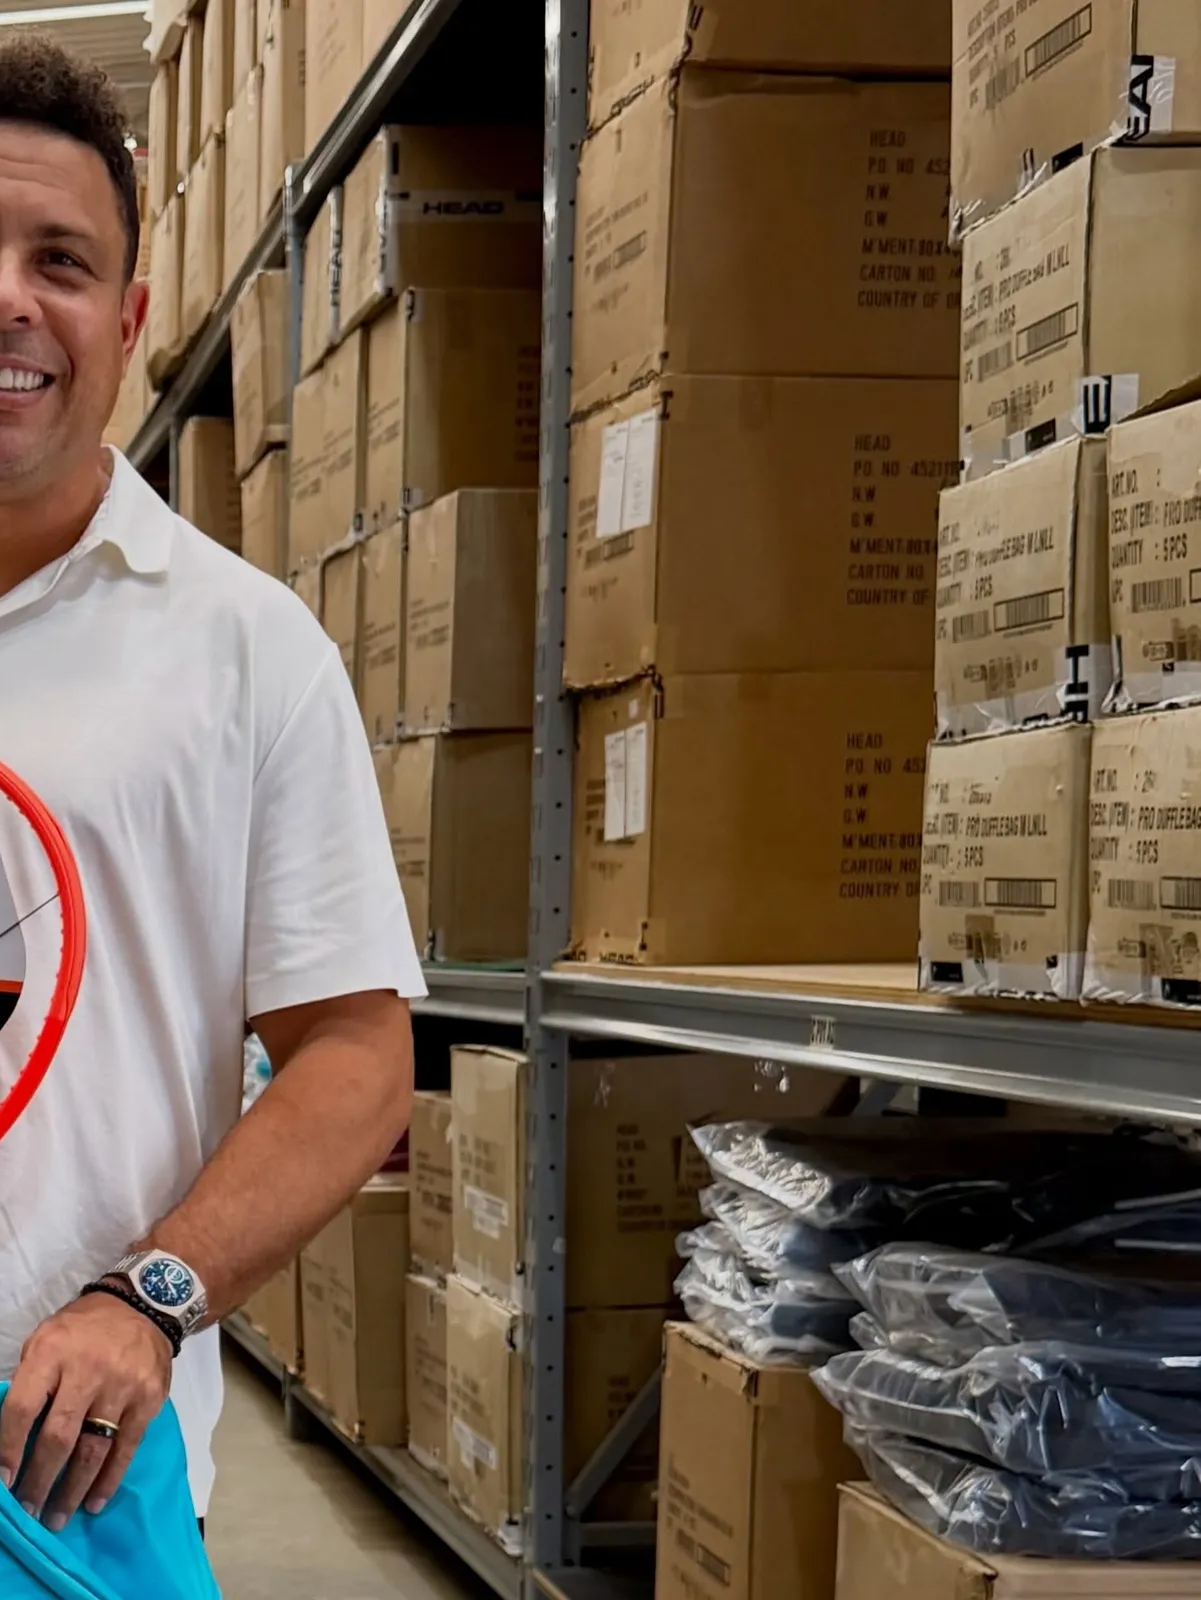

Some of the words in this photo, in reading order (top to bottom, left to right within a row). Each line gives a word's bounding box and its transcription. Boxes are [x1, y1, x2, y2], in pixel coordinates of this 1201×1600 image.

[869, 129, 906, 149] HEAD
[423, 202, 504, 215] HEAD
[859, 263, 911, 282] CARTON
[858, 290, 917, 309] COUNTRY
[855, 434, 891, 451] HEAD
[1111, 539, 1144, 569] QUANTITY
[848, 563, 899, 580] CARTON
[846, 588, 906, 605] COUNTRY
[912, 588, 929, 605] OF
[846, 733, 883, 749] HEAD
[1137, 806, 1155, 830] PRO
[839, 858, 892, 874] CARTON
[839, 882, 899, 898] COUNTRY
